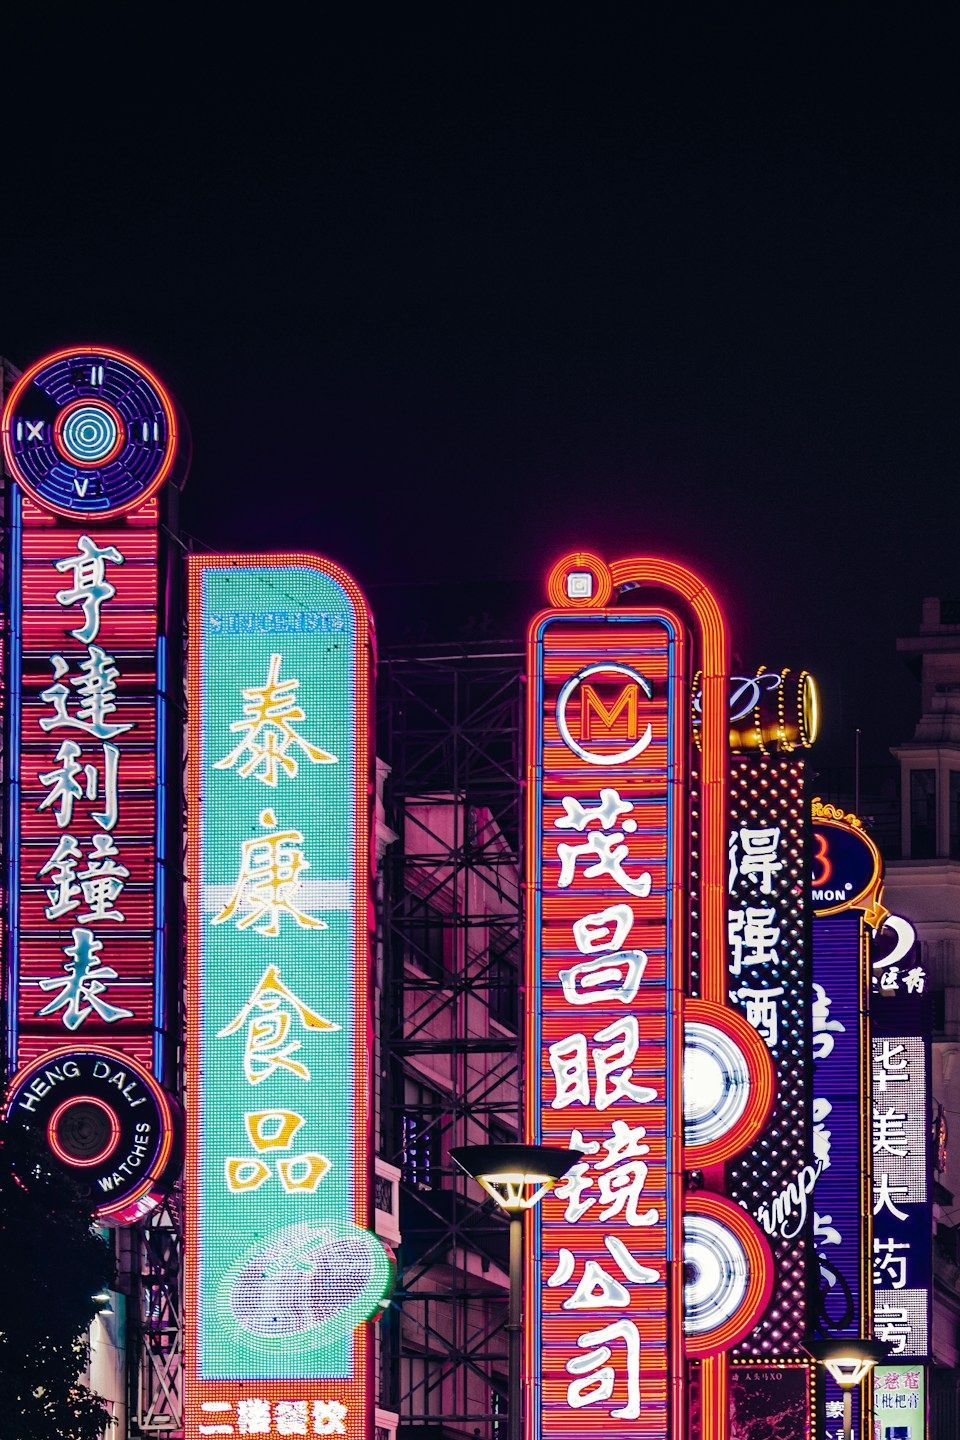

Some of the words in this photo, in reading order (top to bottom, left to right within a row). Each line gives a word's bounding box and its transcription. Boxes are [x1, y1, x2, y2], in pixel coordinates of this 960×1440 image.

[16, 420, 45, 442] IX
[210, 653, 342, 1195] 泰康食品
[873, 966, 926, 994] 医药
[18, 1061, 81, 1113] HENG
[92, 1061, 148, 1108] DALI
[547, 787, 660, 1420] 茂昌眼镜公司
[98, 1121, 152, 1194] WATCHES
[874, 1371, 920, 1390] 慈菴
